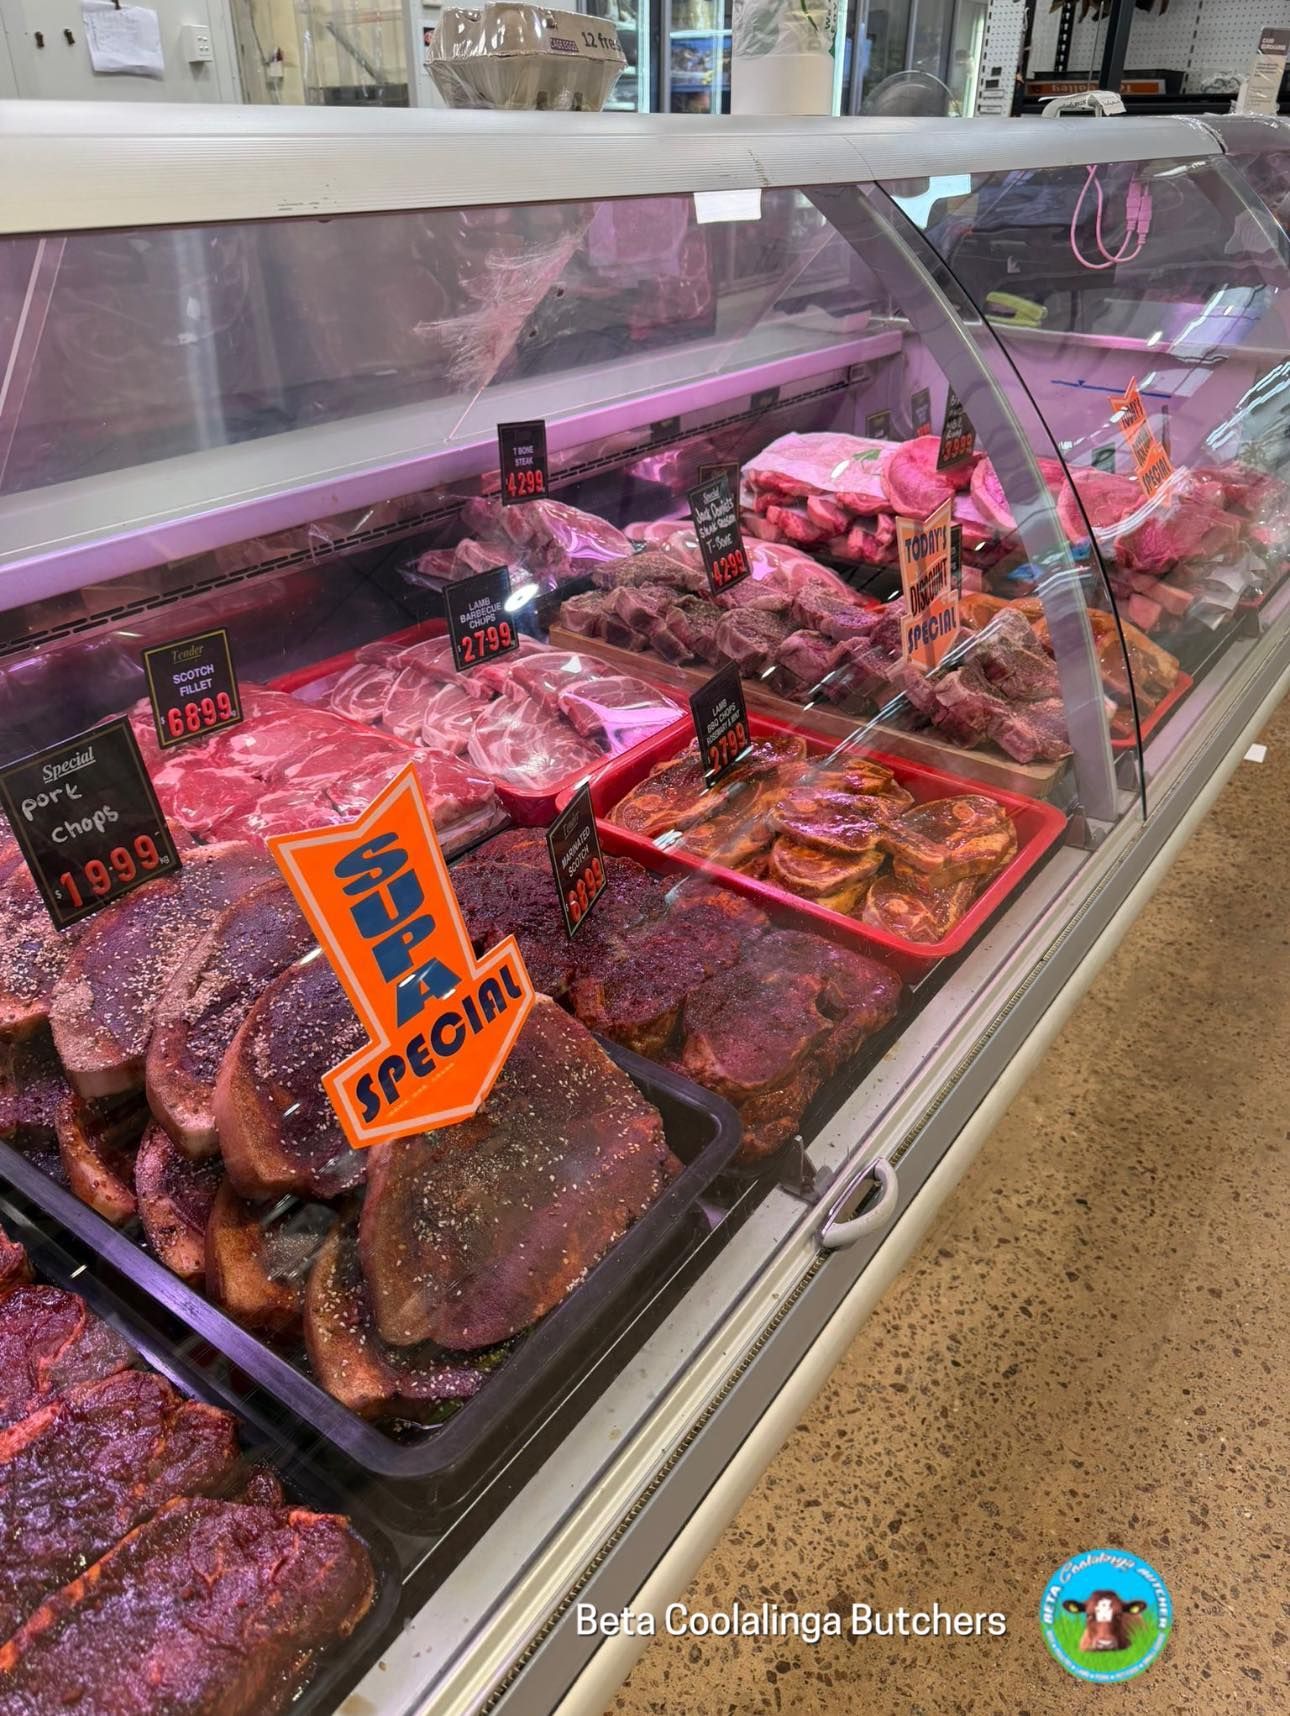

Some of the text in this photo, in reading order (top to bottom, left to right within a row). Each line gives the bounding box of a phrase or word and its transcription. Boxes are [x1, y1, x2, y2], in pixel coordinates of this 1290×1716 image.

[581, 32, 599, 48] 12
[905, 525, 947, 563] TODAY'S
[460, 602, 502, 623] BARBECUE
[468, 597, 491, 611] LAMB
[469, 614, 496, 629] CHOPS
[907, 607, 957, 654] SPECIAL
[173, 644, 204, 661] Tender
[172, 663, 215, 684] SCOTCH
[179, 678, 213, 697] FILLET
[711, 698, 727, 717] LAMB
[718, 702, 737, 722] CHOPS
[42, 746, 95, 781] Special
[561, 825, 591, 870] MARINATED
[568, 843, 590, 878] SCOTCH
[334, 831, 463, 1030] SUPA
[355, 963, 523, 1125] SPECIAL
